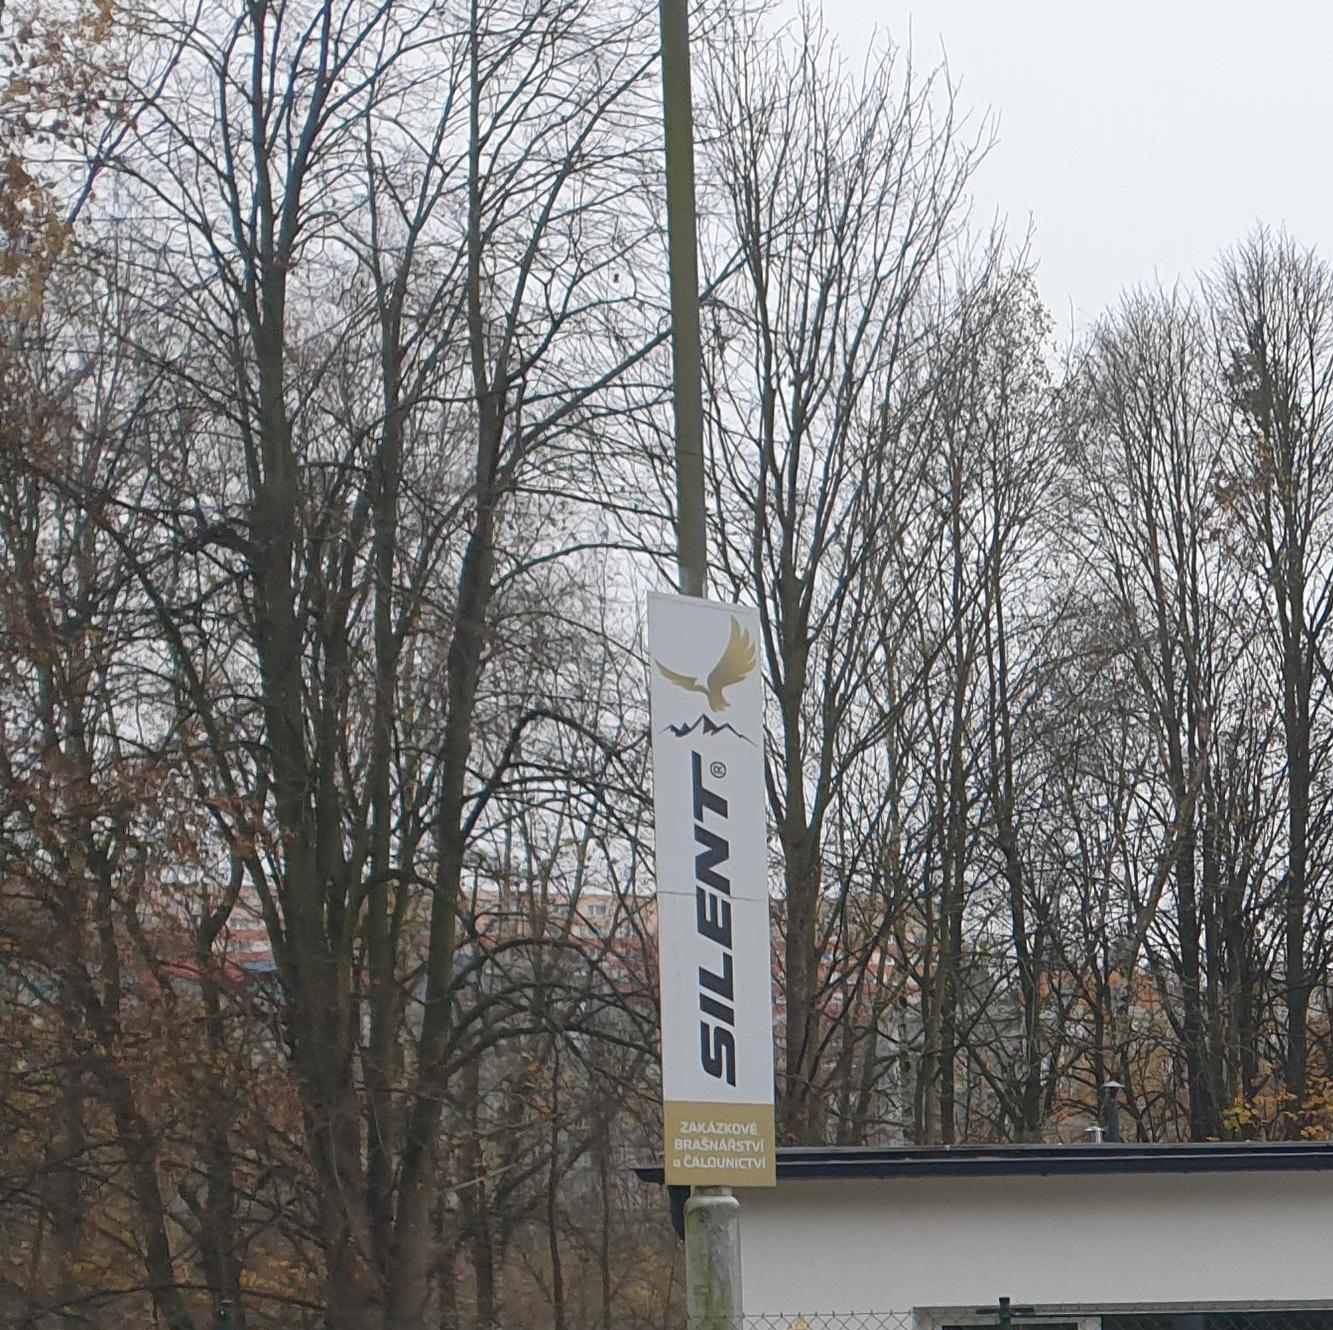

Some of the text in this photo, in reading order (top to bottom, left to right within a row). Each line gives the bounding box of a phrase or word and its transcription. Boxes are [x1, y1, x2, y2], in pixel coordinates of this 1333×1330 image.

[692, 750, 736, 1087] SILENT
[680, 1120, 758, 1135] ZAKÁZKOVÉ
[674, 1137, 765, 1153] BRAŠNÁŘSTVÍ
[683, 1153, 767, 1169] ČALOUNICTVÍ
